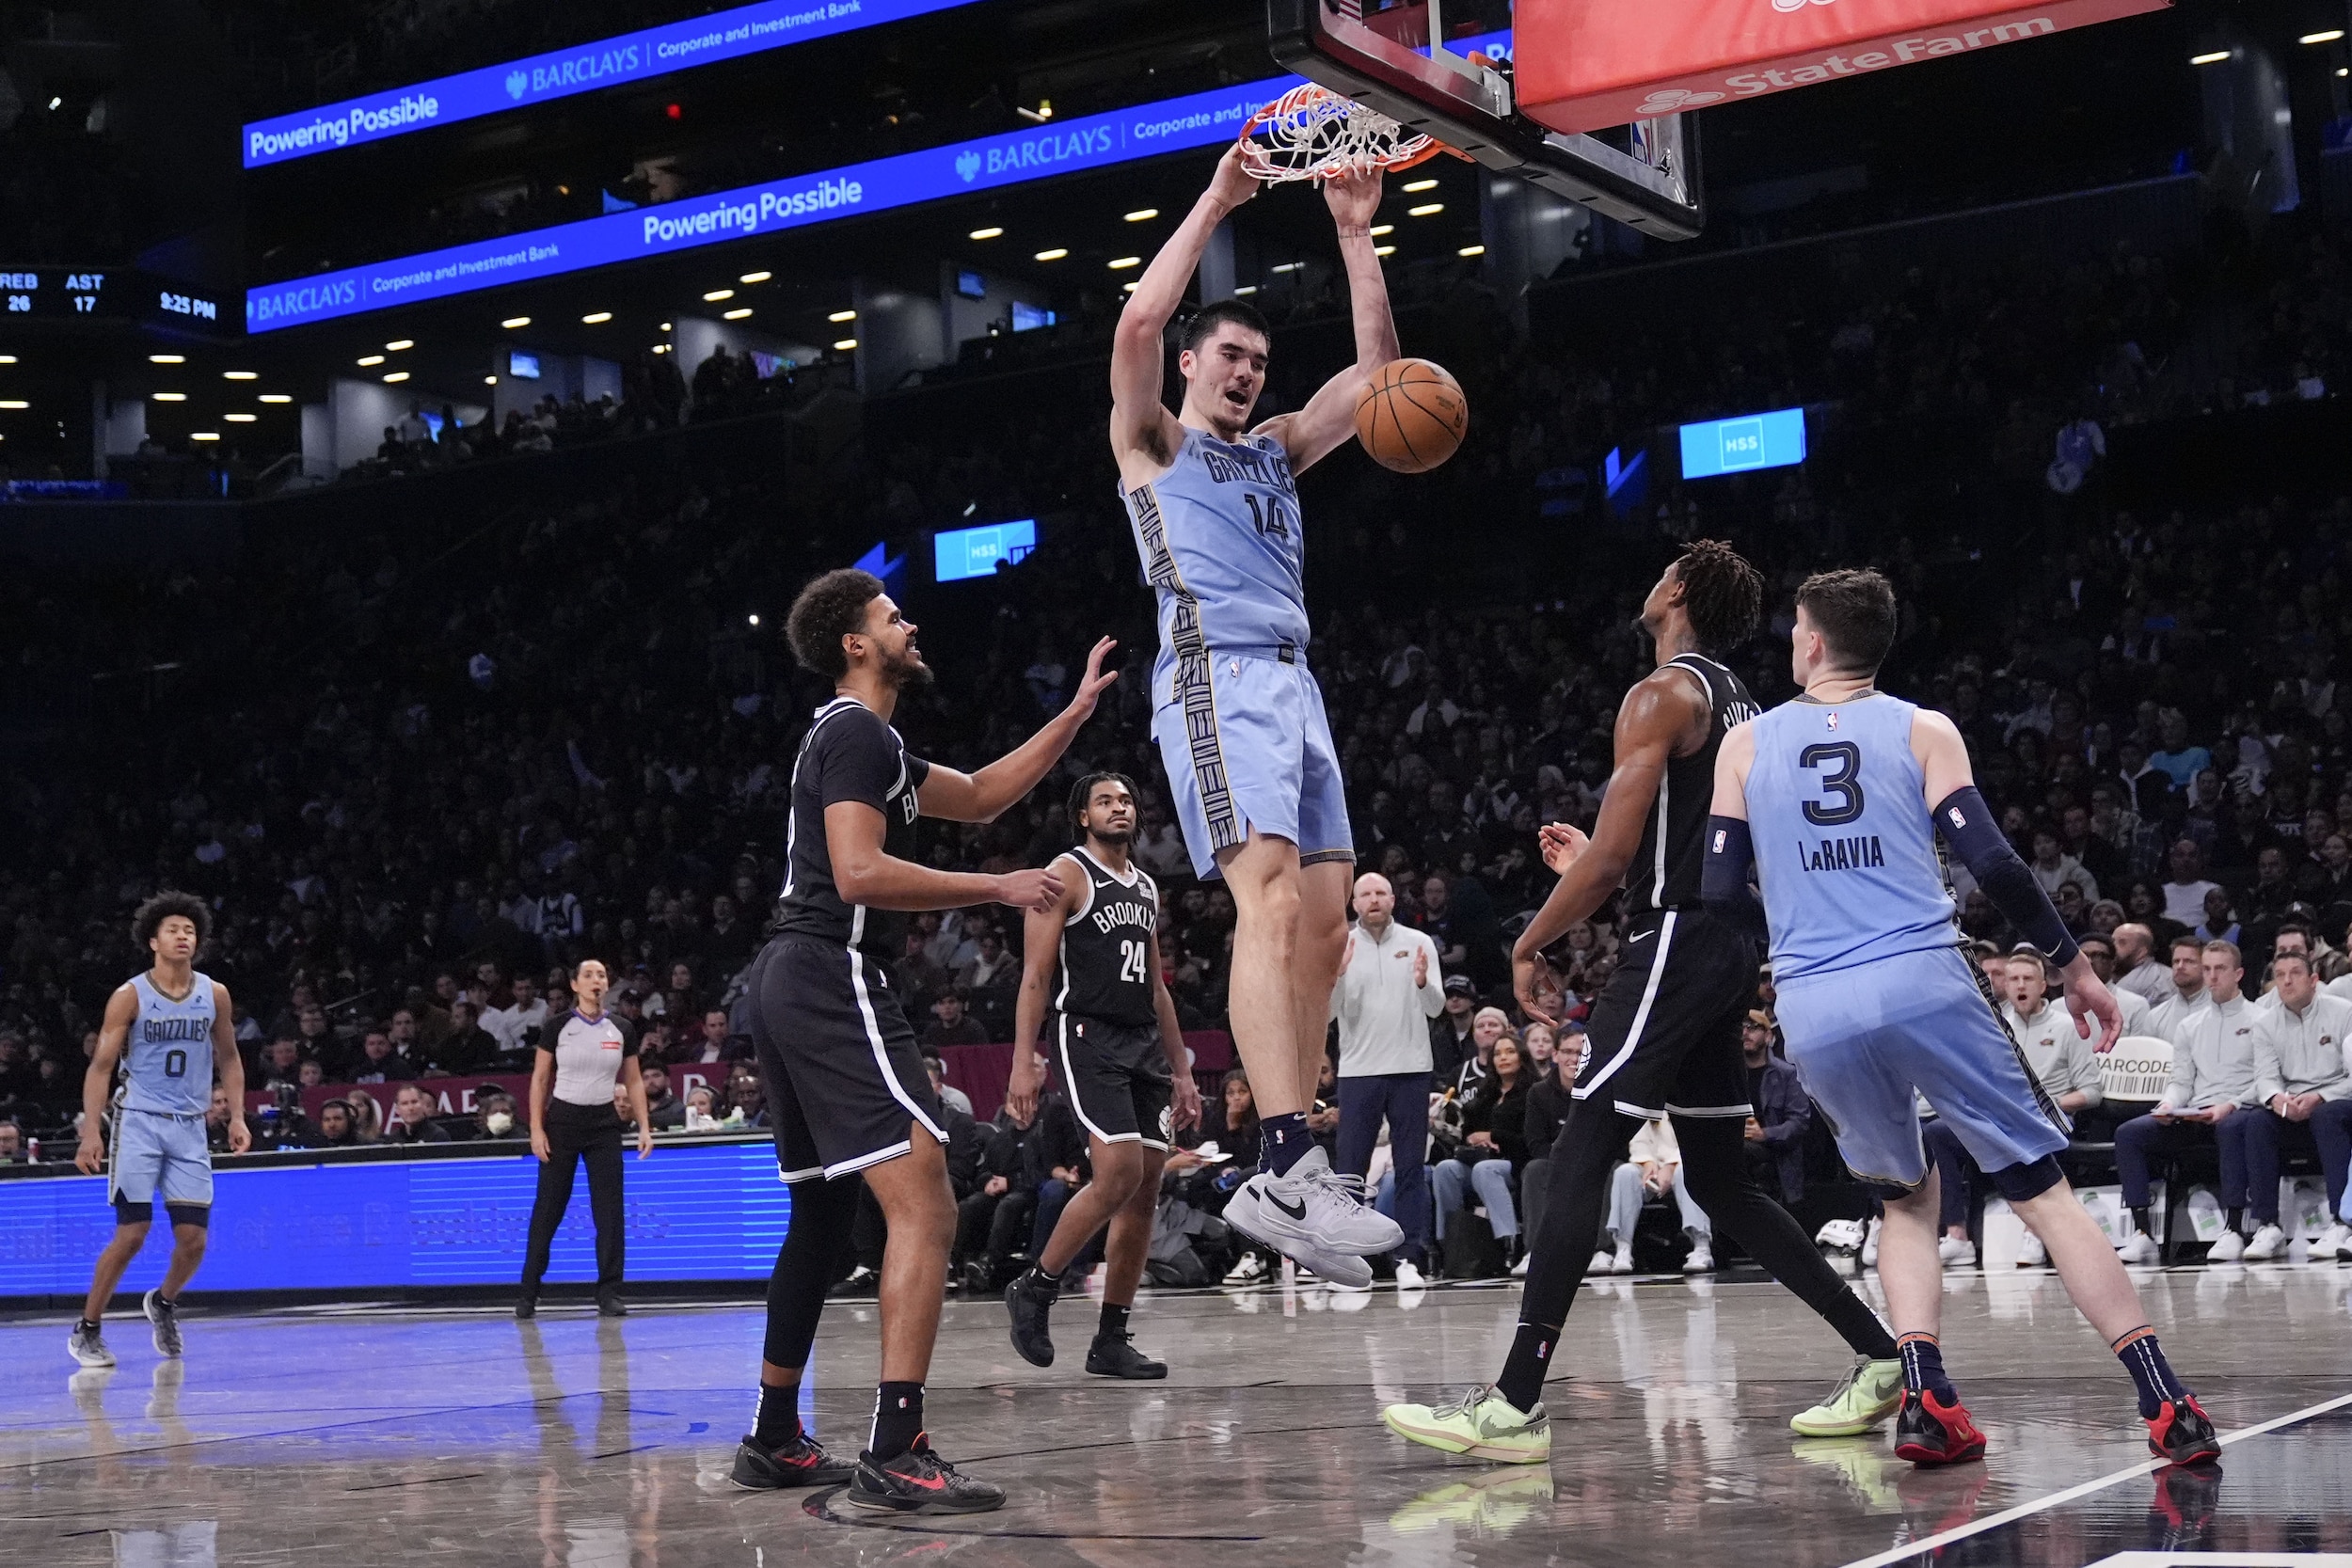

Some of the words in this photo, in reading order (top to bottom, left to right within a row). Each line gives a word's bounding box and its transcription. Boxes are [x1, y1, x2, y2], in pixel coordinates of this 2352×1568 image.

[658, 33, 723, 59] Corporate
[725, 24, 749, 43] and
[752, 7, 826, 36] Investment
[828, 0, 862, 18] Bank
[532, 45, 639, 92] BARCLAYS
[1725, 51, 1890, 95] State
[1892, 17, 2056, 62] Farm
[250, 118, 348, 158] Powering
[350, 93, 439, 135] Possible
[1134, 113, 1211, 140] Corporate
[1214, 103, 1242, 122] and
[986, 125, 1112, 174] BARCLAYS
[644, 201, 757, 245] Powering
[760, 177, 863, 221] Possible
[0, 273, 39, 290] REB
[65, 274, 103, 291] AST
[373, 271, 432, 292] Corporate
[435, 263, 456, 280] and
[459, 250, 527, 277] Investment
[529, 243, 559, 261] Bank
[8, 294, 31, 311] 26
[73, 295, 96, 311] 17
[160, 292, 191, 314] 9:25
[193, 298, 216, 321] PM
[258, 279, 356, 321] BARCLAYS
[1725, 435, 1758, 452] HSS
[1202, 451, 1295, 495] GRIZZLIE
[1244, 493, 1289, 545] 14
[970, 543, 997, 559] HSS
[1799, 740, 1865, 826] 3
[1120, 939, 1147, 984] 24
[144, 1017, 210, 1044] GRIZZLIES
[165, 1049, 186, 1078] 0
